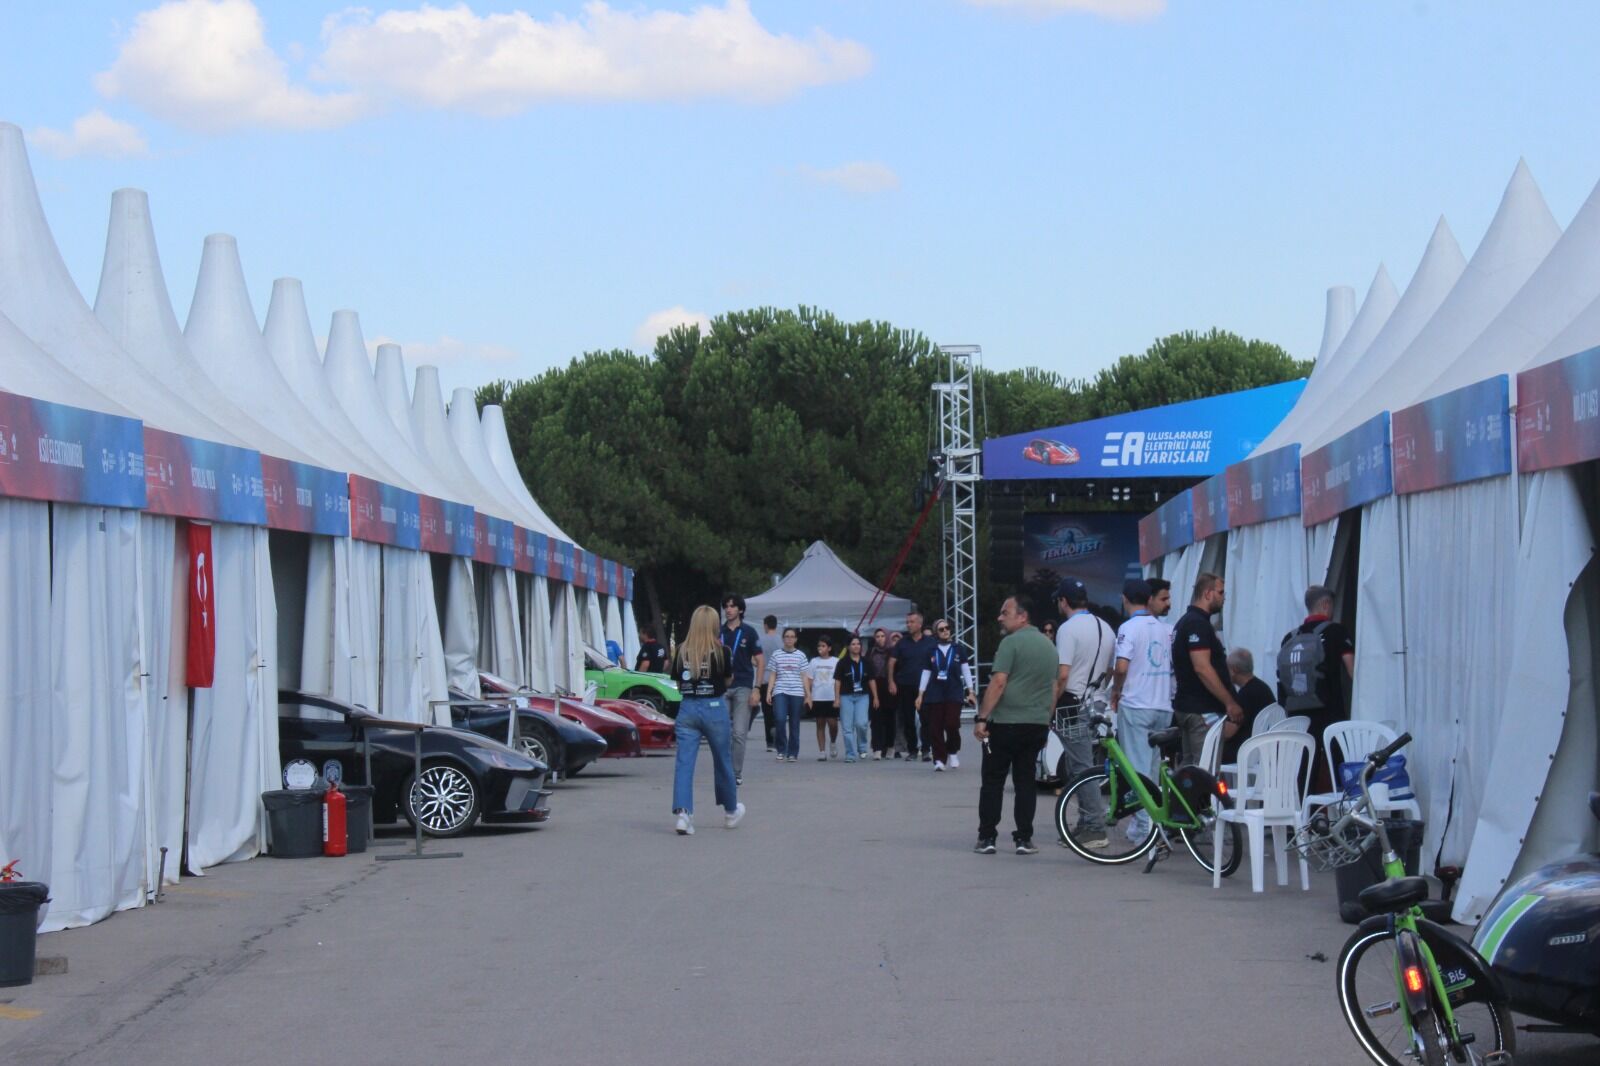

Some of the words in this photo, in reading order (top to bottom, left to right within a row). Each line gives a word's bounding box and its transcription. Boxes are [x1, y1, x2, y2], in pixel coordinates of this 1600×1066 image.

[1147, 430, 1213, 441] ULUSLARARASI
[1144, 440, 1189, 451] ELEKTRİKLİ
[1144, 450, 1210, 465] YARIŞLARI
[1041, 540, 1102, 561] TEKNOFEST
